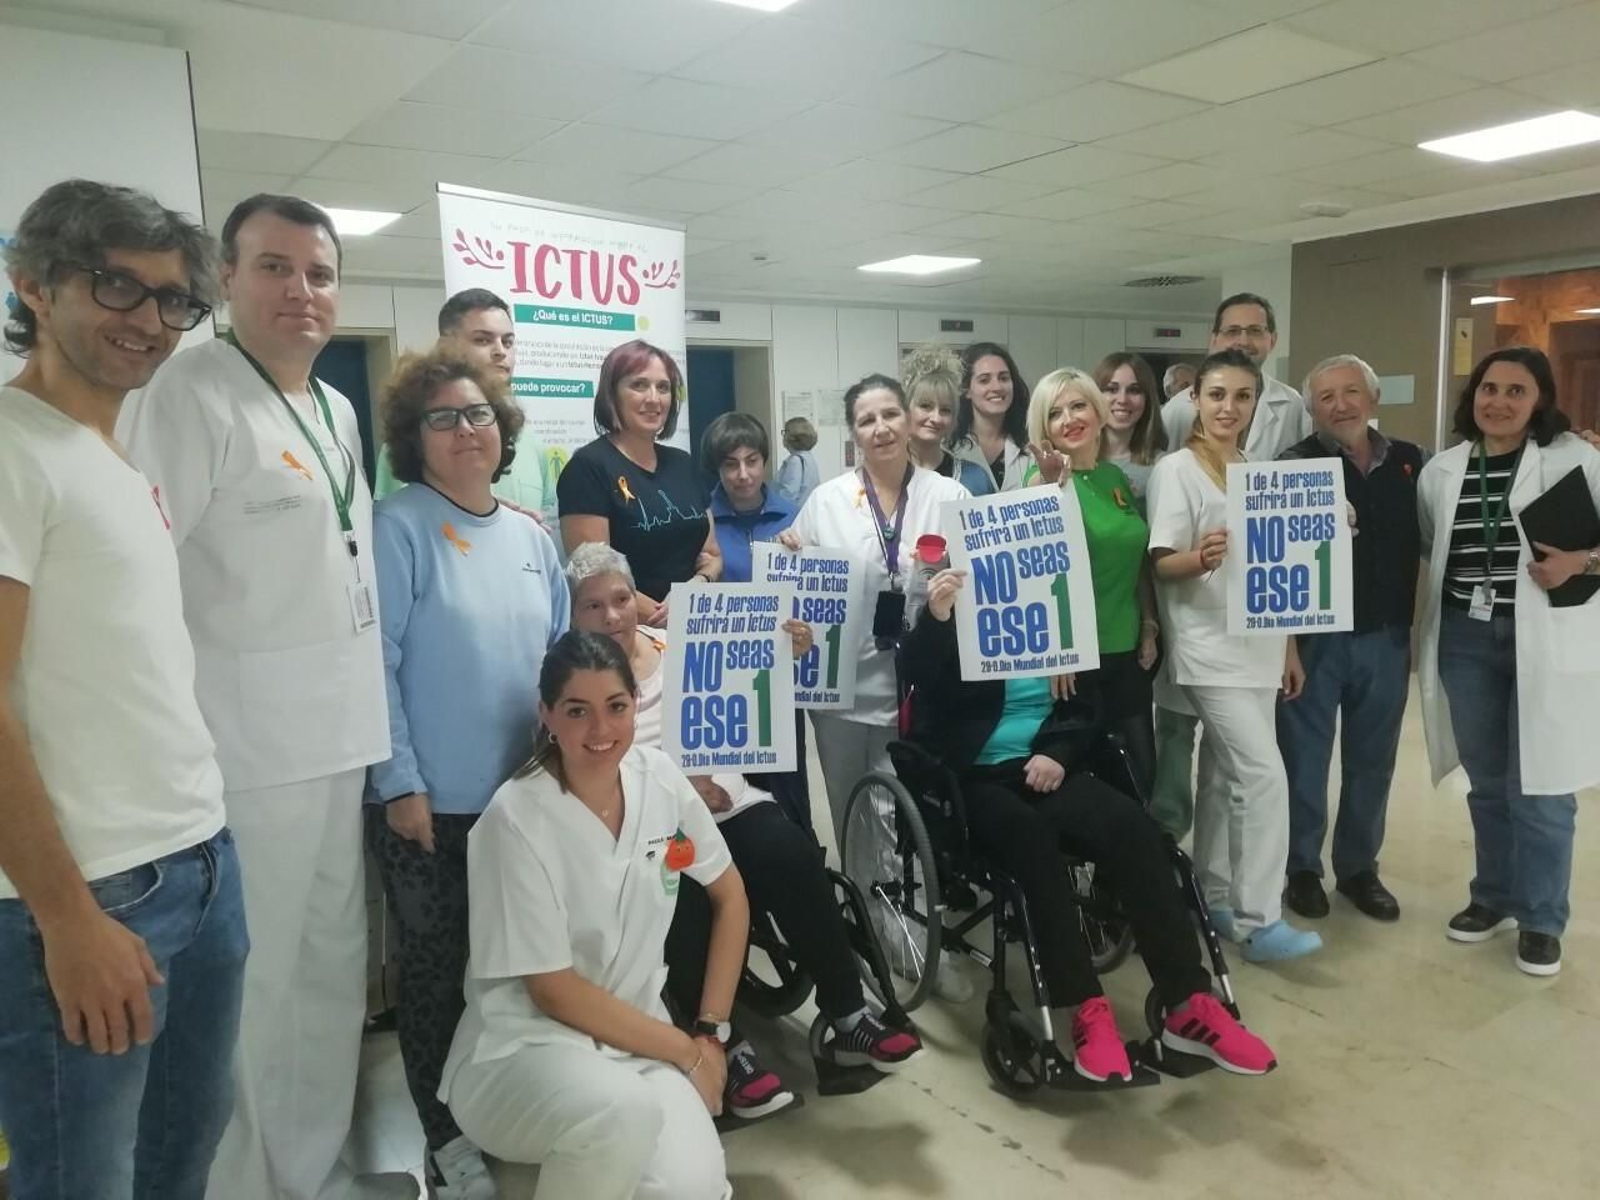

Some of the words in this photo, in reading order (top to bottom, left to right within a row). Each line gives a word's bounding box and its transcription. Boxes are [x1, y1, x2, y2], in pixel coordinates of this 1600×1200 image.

[507, 241, 640, 305] ICTUS
[533, 310, 557, 321] ¿Qué
[558, 313, 570, 322] es
[572, 312, 580, 322] el
[582, 312, 613, 326] ICTUS?
[510, 381, 539, 392] puede
[540, 382, 586, 395] provocar?
[1246, 473, 1250, 491] 1
[1254, 472, 1267, 491] de
[1270, 471, 1279, 489] 4
[1283, 471, 1333, 492] personas
[1290, 492, 1304, 508] un
[1307, 488, 1335, 507] Ictus
[960, 510, 966, 530] 1
[968, 509, 984, 529] de
[988, 505, 996, 524] 4
[1000, 496, 1059, 525] personas
[1013, 522, 1030, 541] un
[1030, 516, 1064, 537] Ictus
[1247, 516, 1285, 564] NO
[1288, 512, 1335, 542] seas
[768, 552, 772, 570] 1
[774, 554, 787, 570] de
[790, 554, 796, 572] 4
[800, 558, 850, 575] personas
[971, 551, 1018, 606] NO
[1017, 541, 1070, 579] seas
[806, 576, 819, 592] un
[821, 574, 848, 592] Ictus
[1246, 564, 1310, 614] ese
[1315, 541, 1331, 610] 1
[690, 593, 694, 614] 1
[697, 593, 712, 613] de
[714, 592, 724, 612] 4
[726, 595, 780, 616] personas
[802, 597, 846, 624] seas
[977, 602, 1050, 658] ese
[1050, 572, 1074, 650] 1
[731, 616, 746, 633] un
[747, 613, 777, 633] Ictus
[1276, 614, 1303, 628] Mundial
[1304, 614, 1316, 626] del
[682, 640, 724, 693] NO
[726, 639, 774, 670] seas
[826, 624, 841, 689] 1
[1014, 656, 1044, 671] Mundial
[1046, 655, 1058, 668] del
[1059, 653, 1080, 666] Ictus
[813, 691, 822, 703] del
[680, 694, 748, 751] ese
[752, 670, 772, 747] 1
[712, 751, 742, 766] Mundial
[744, 750, 754, 764] del
